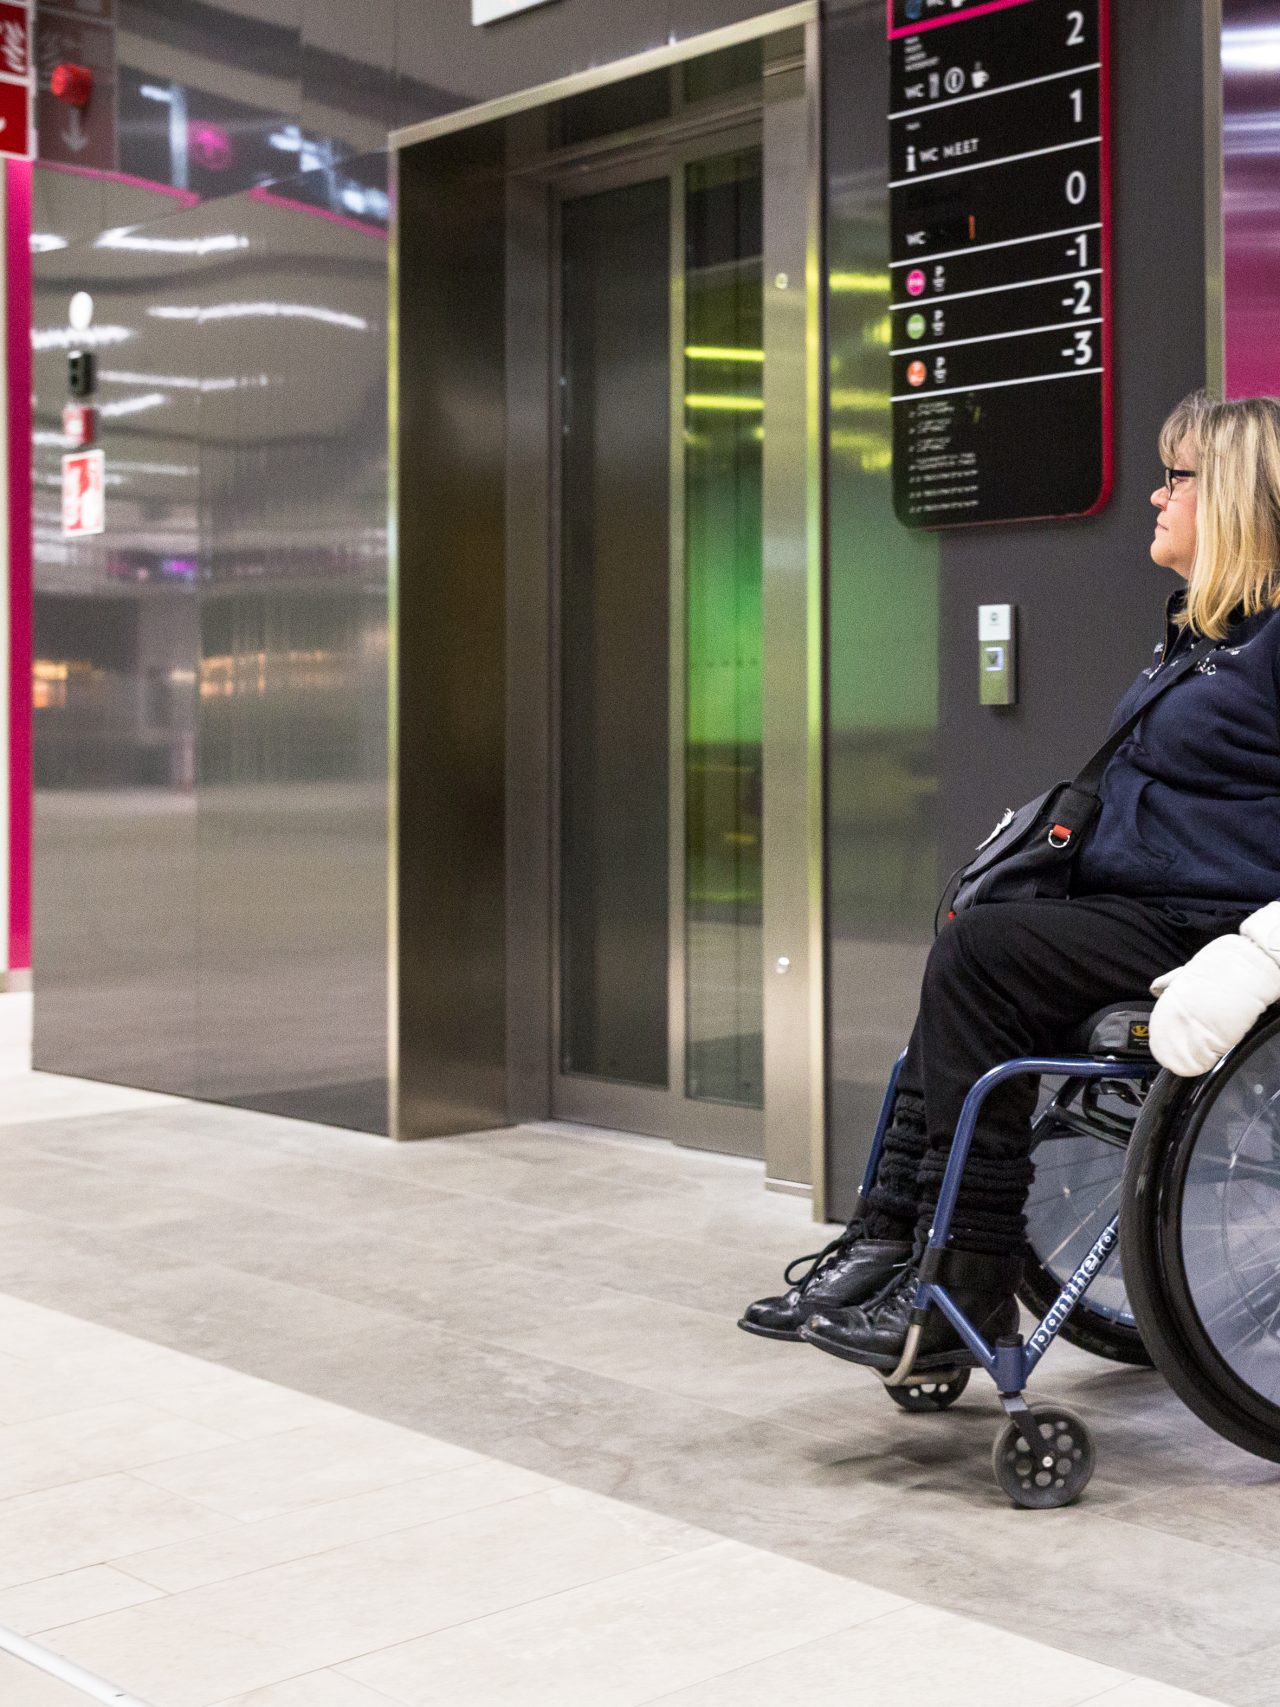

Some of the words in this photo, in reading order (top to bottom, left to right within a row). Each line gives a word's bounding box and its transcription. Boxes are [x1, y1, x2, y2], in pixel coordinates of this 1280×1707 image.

[1066, 11, 1085, 46] 2
[904, 83, 925, 99] WC
[1069, 88, 1083, 123] 1
[919, 147, 939, 162] WC
[943, 138, 979, 158] MEET
[1065, 170, 1087, 205] 0
[906, 231, 926, 246] WC
[1065, 233, 1088, 268] -1
[1062, 280, 1092, 315] -2
[1062, 330, 1093, 365] -3
[1029, 1226, 1118, 1354] panthera
